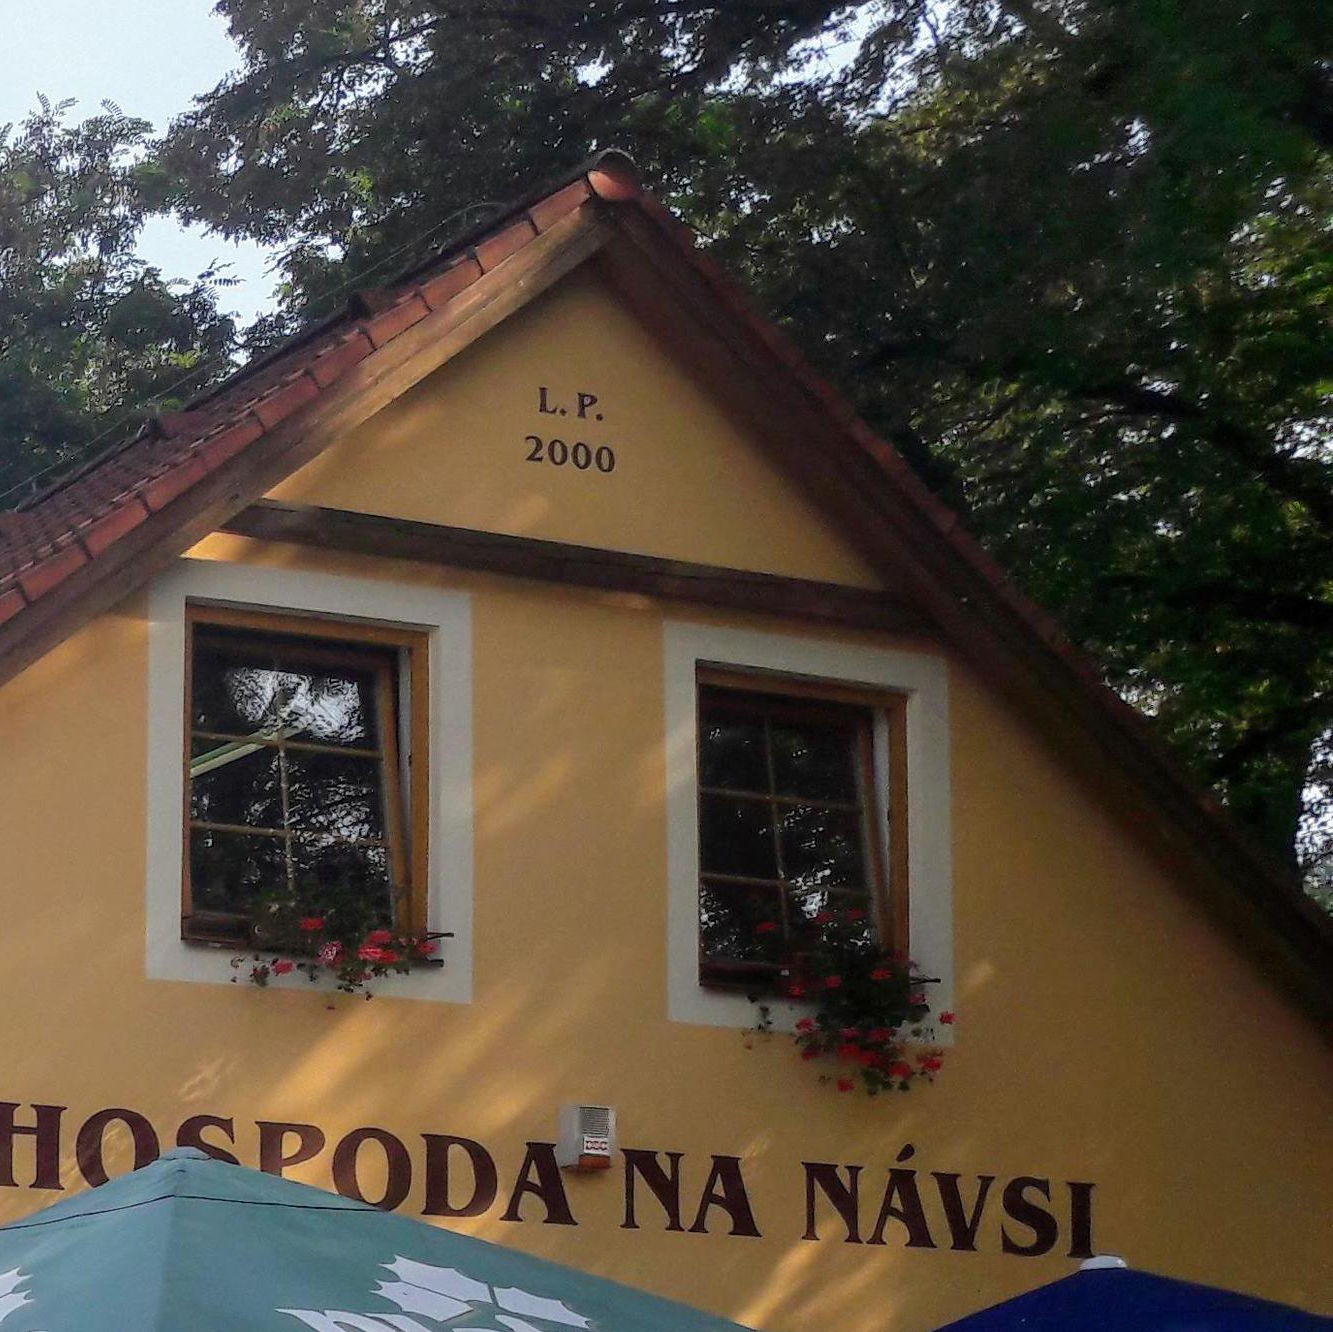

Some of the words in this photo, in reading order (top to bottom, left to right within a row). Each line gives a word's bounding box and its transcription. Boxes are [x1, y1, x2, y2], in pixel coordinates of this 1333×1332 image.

[524, 435, 616, 473] 2000
[620, 1148, 763, 1238] NA
[801, 1143, 1096, 1259] NÁVSI
